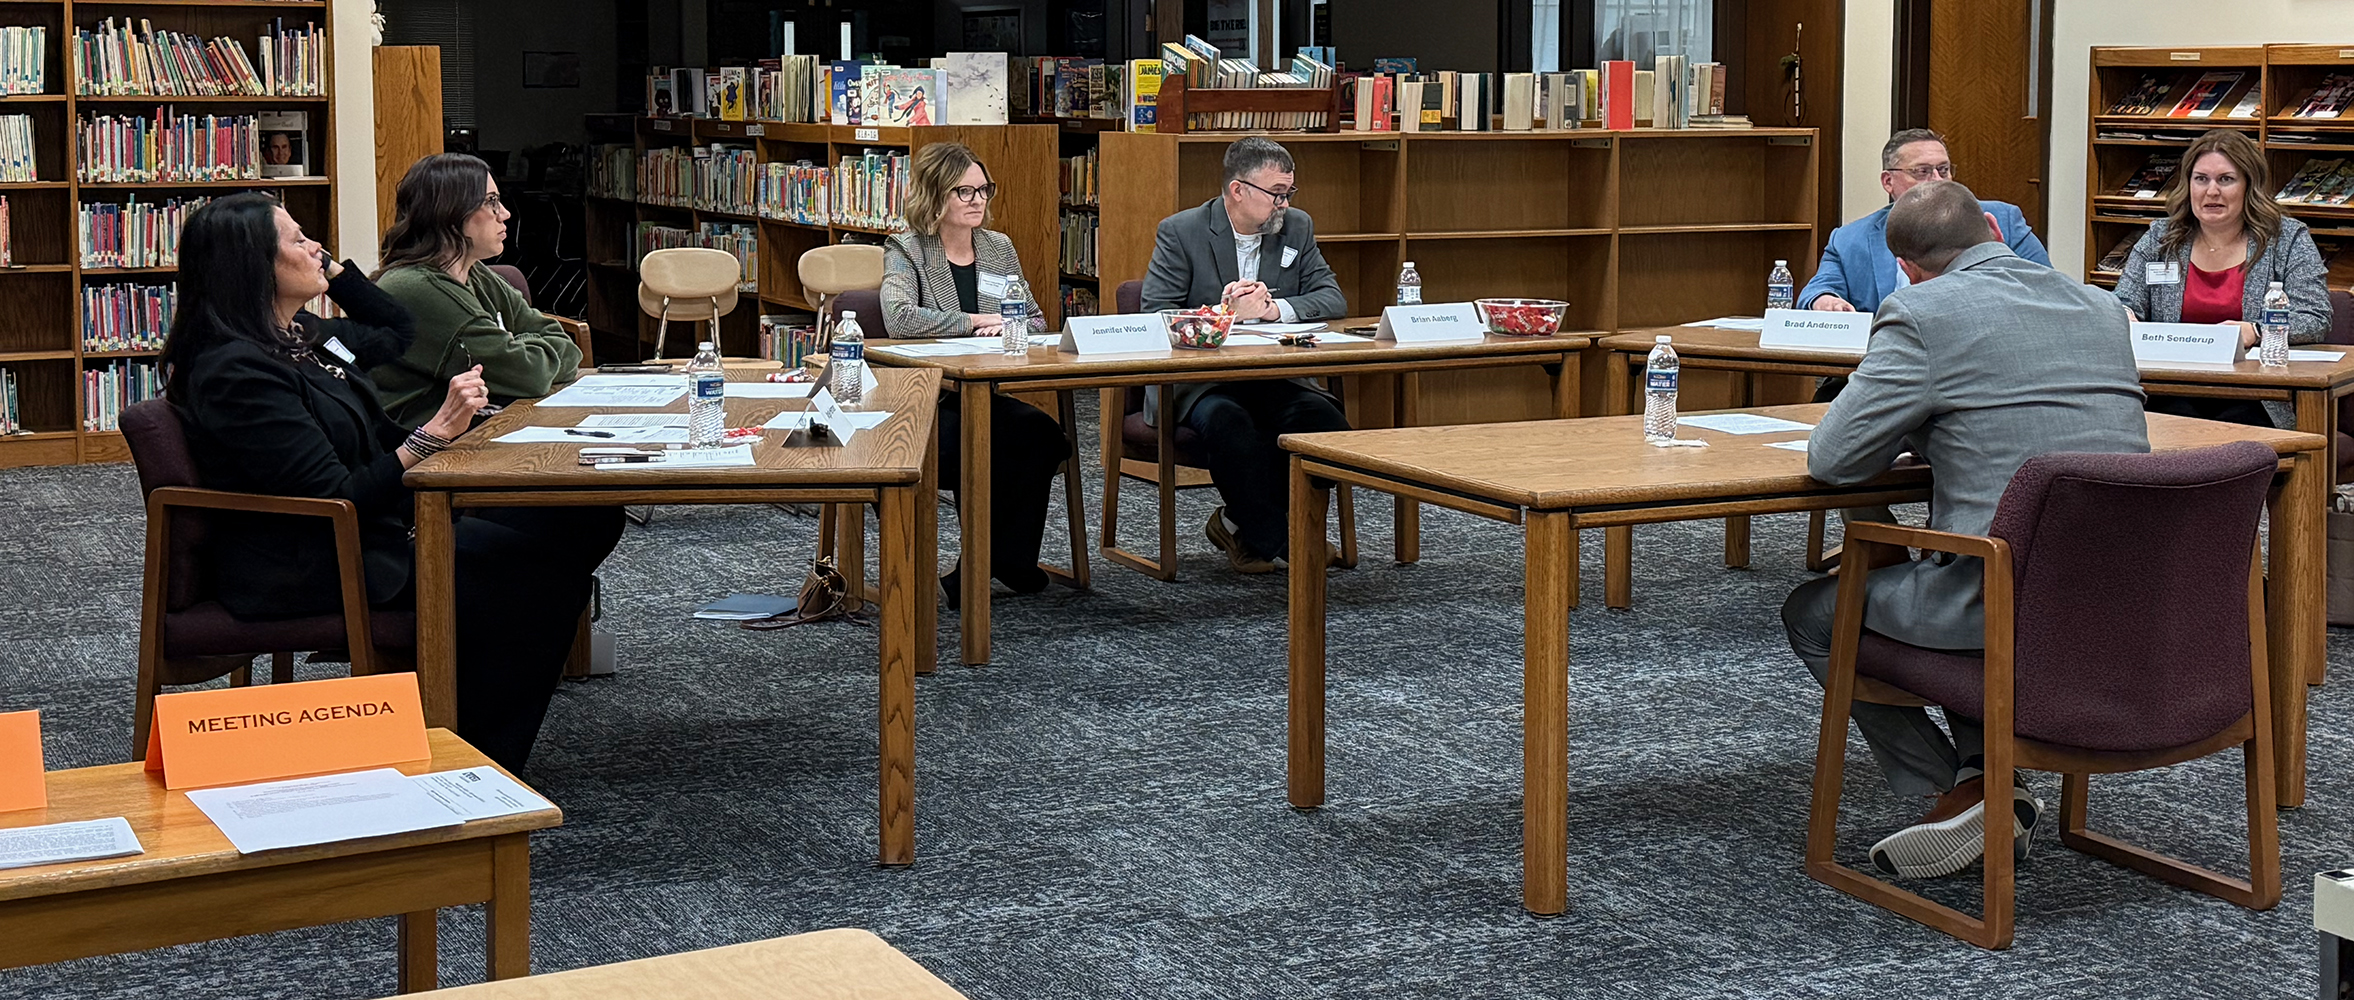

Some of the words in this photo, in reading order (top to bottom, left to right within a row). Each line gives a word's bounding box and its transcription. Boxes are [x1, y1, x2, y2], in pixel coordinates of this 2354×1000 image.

[1092, 326, 1123, 335] Jennifer
[1123, 324, 1148, 333] Wood
[1784, 320, 1805, 328] Brad
[1806, 321, 1850, 330] Anderson
[2141, 333, 2165, 342] Beth
[187, 711, 292, 734] MEETING
[298, 701, 395, 724] AGENDA
